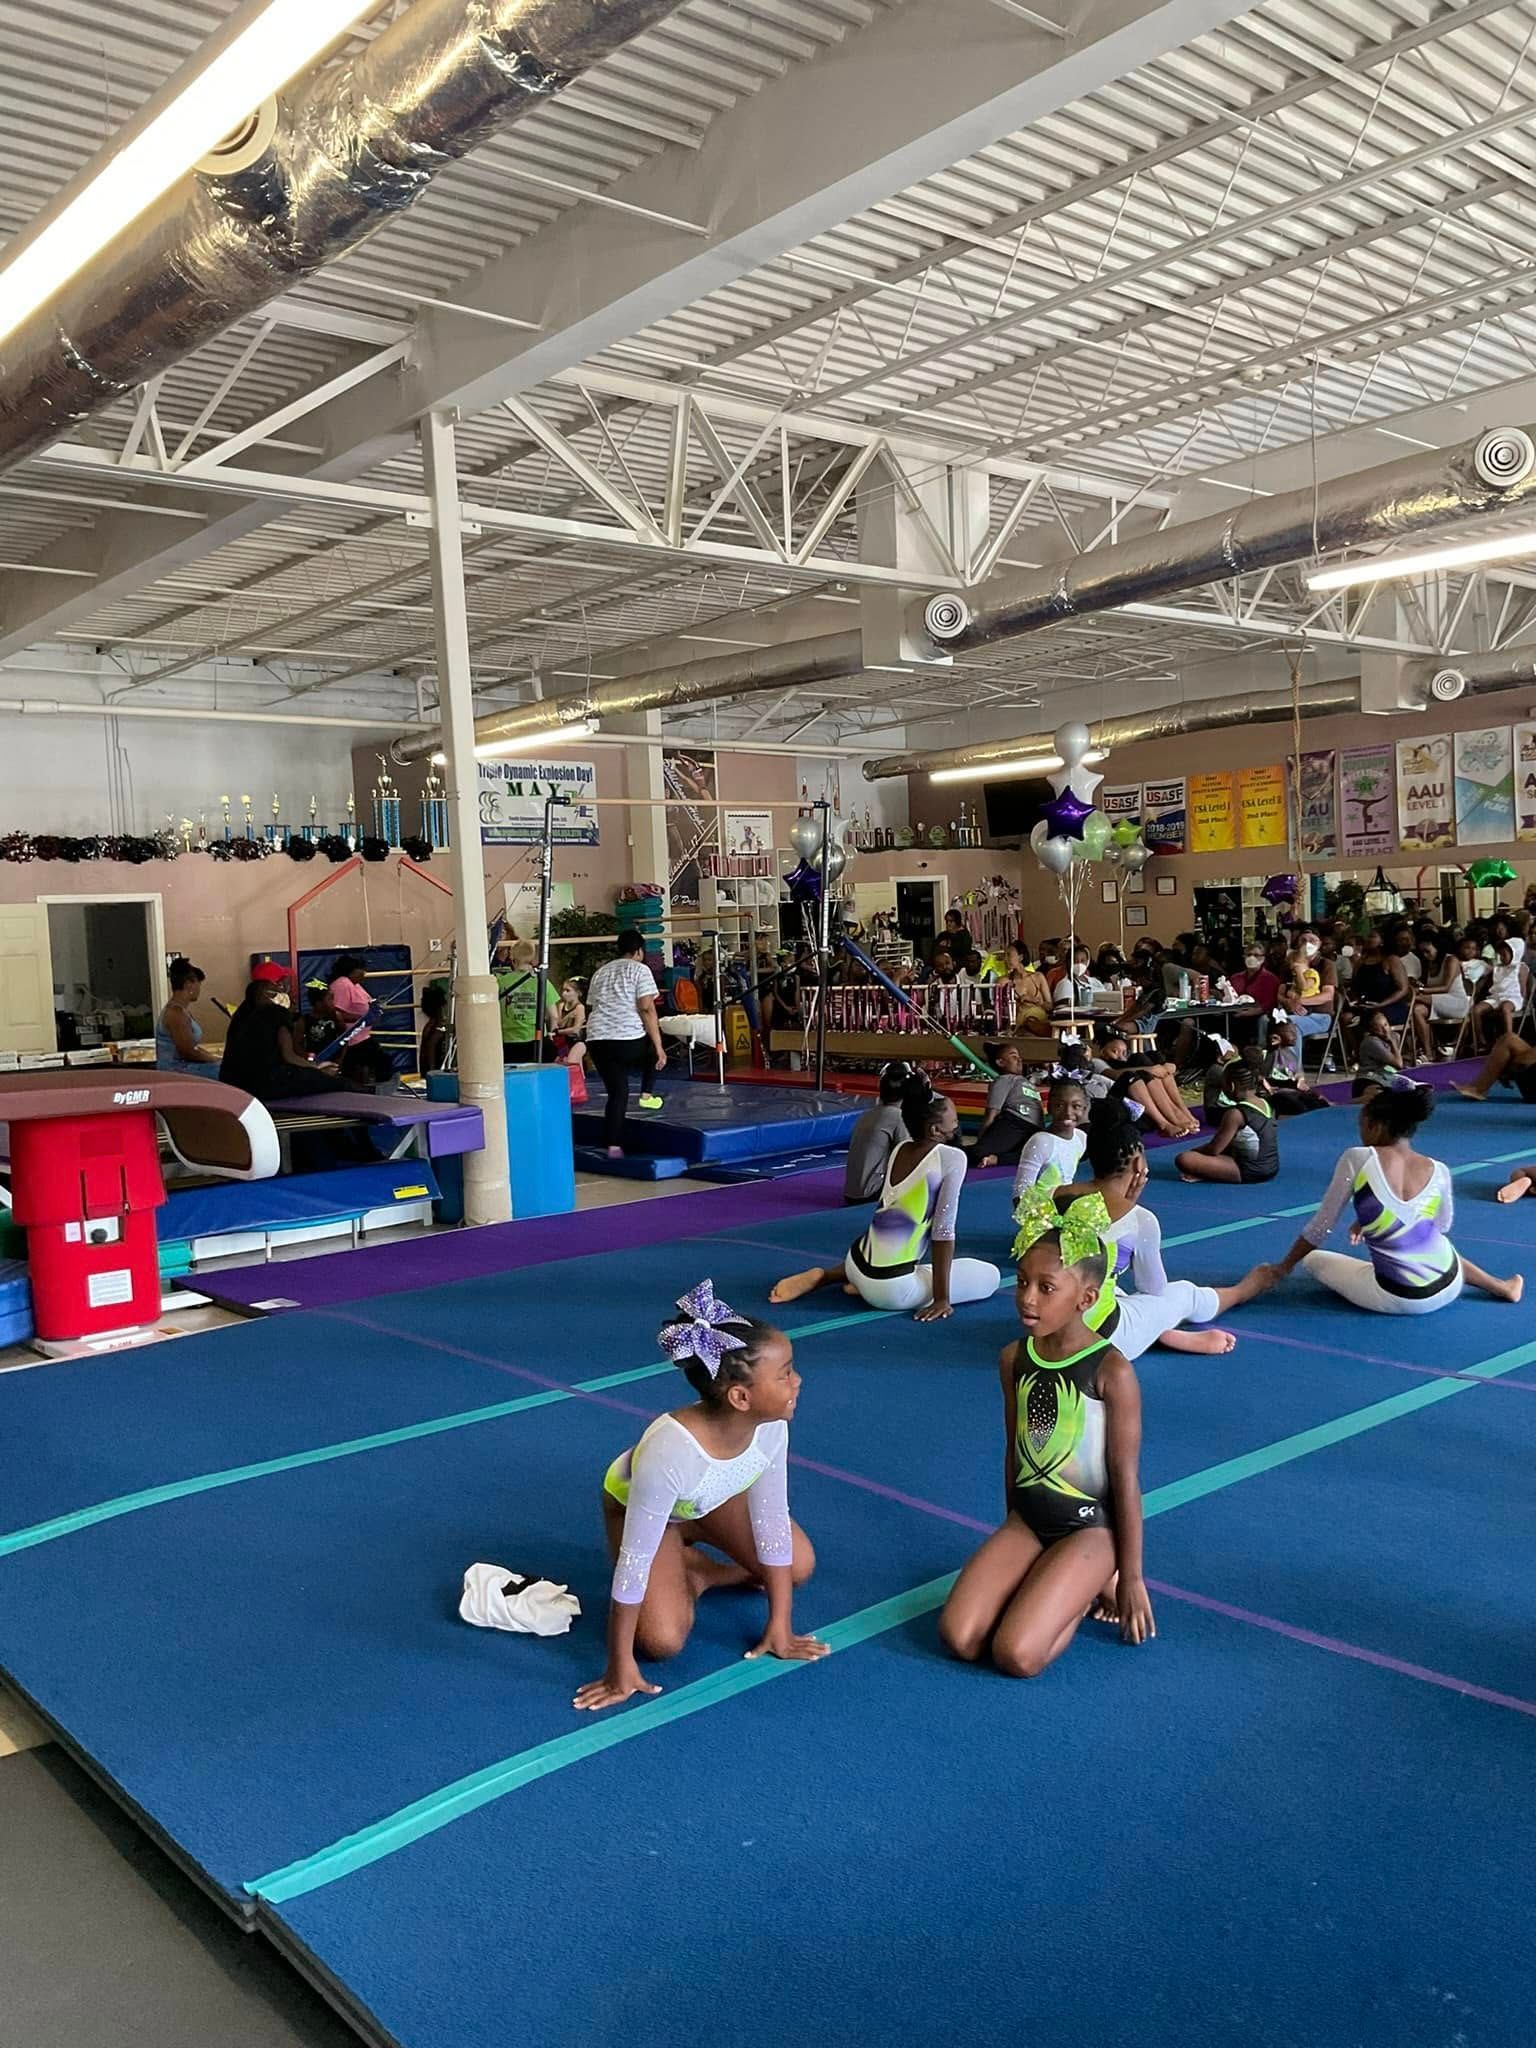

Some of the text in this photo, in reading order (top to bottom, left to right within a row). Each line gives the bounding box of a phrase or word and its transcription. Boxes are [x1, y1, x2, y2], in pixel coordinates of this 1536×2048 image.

[504, 763, 537, 781] Dynamic
[539, 764, 575, 781] Explosion
[576, 766, 593, 783] Day!
[506, 781, 561, 799] MAY
[1146, 788, 1184, 802] USASF
[1406, 783, 1445, 800] AAU
[1104, 795, 1139, 809] USASF
[1208, 802, 1226, 812] Level
[1257, 796, 1276, 806] Level
[1407, 799, 1438, 811] LEVEL
[1346, 846, 1393, 857] 1ST PLACE
